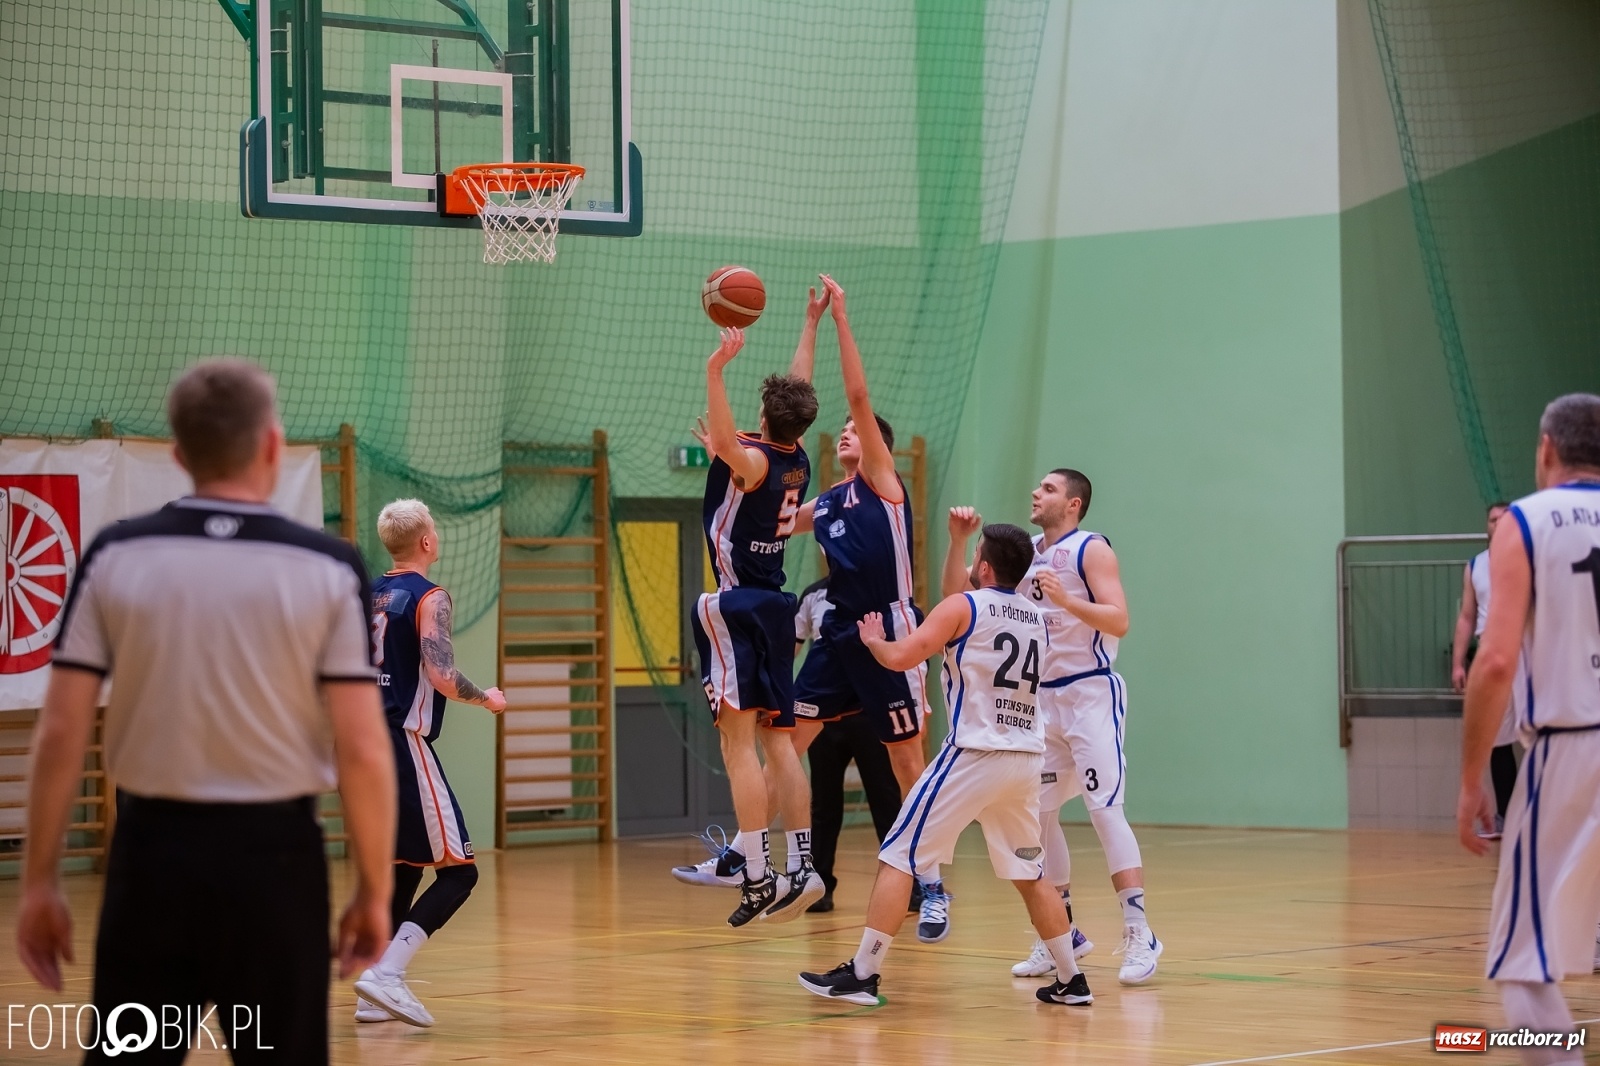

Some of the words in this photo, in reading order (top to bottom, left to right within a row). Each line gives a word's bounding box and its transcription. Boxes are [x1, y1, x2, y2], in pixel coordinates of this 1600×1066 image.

[775, 489, 800, 538] 5
[1031, 578, 1043, 601] 3
[1002, 603, 1040, 626] PÓŁTORAK
[993, 632, 1040, 695] 24
[888, 707, 915, 735] 11
[1085, 768, 1099, 792] 3
